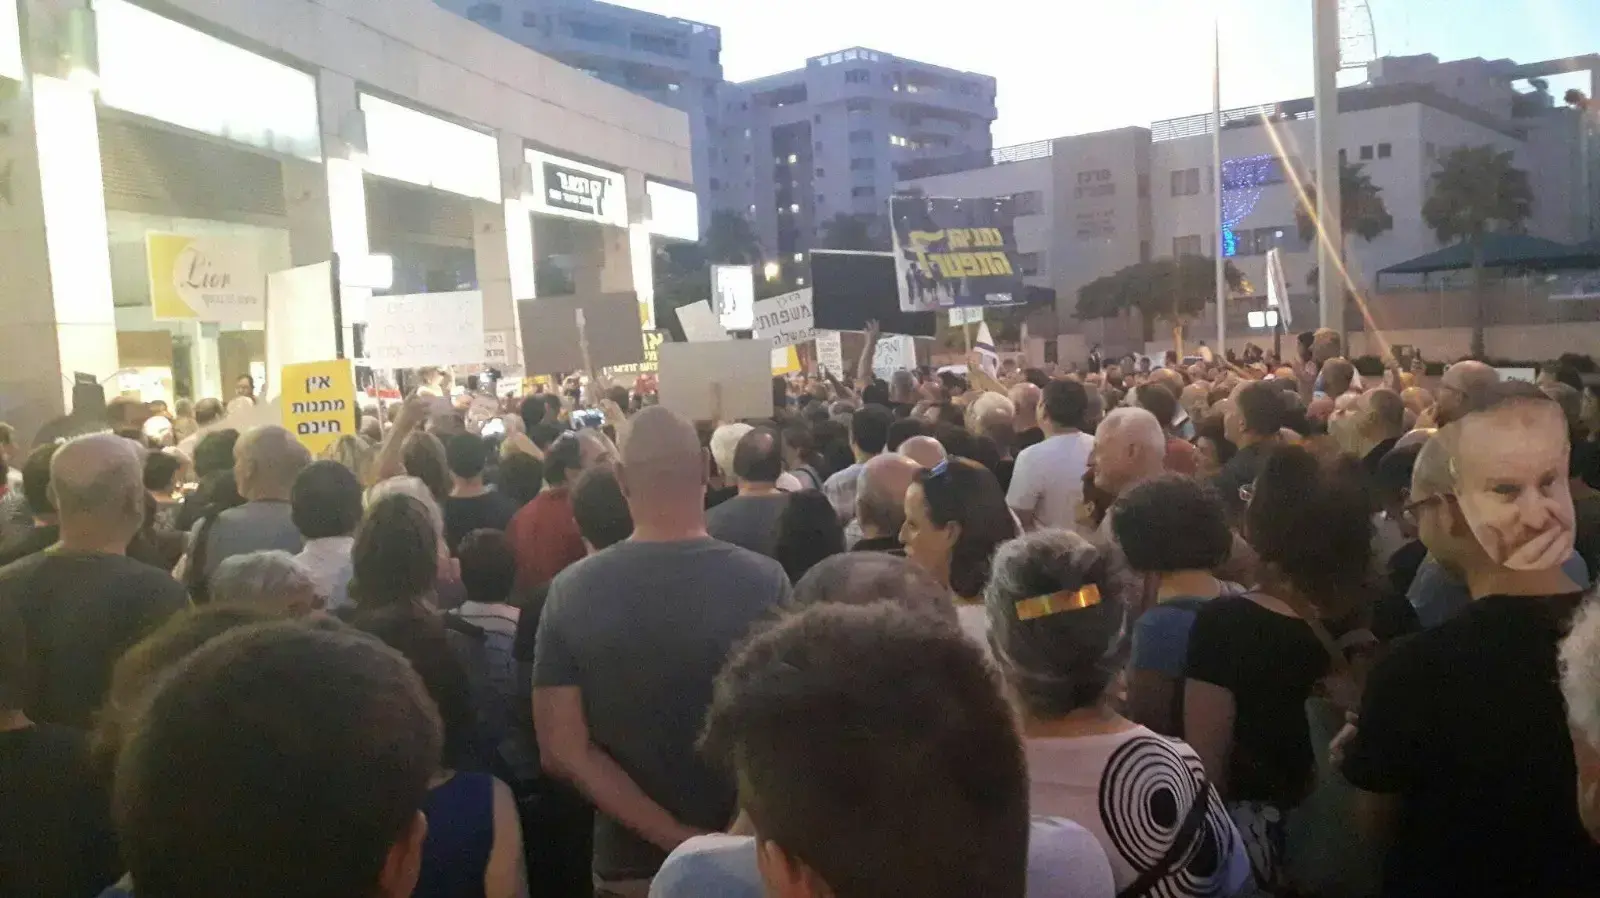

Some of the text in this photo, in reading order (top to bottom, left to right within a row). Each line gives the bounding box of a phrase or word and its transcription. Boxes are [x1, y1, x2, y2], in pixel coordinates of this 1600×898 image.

[305, 375, 331, 393] אין
[292, 398, 345, 414] מתנות
[297, 418, 341, 434] חינם
